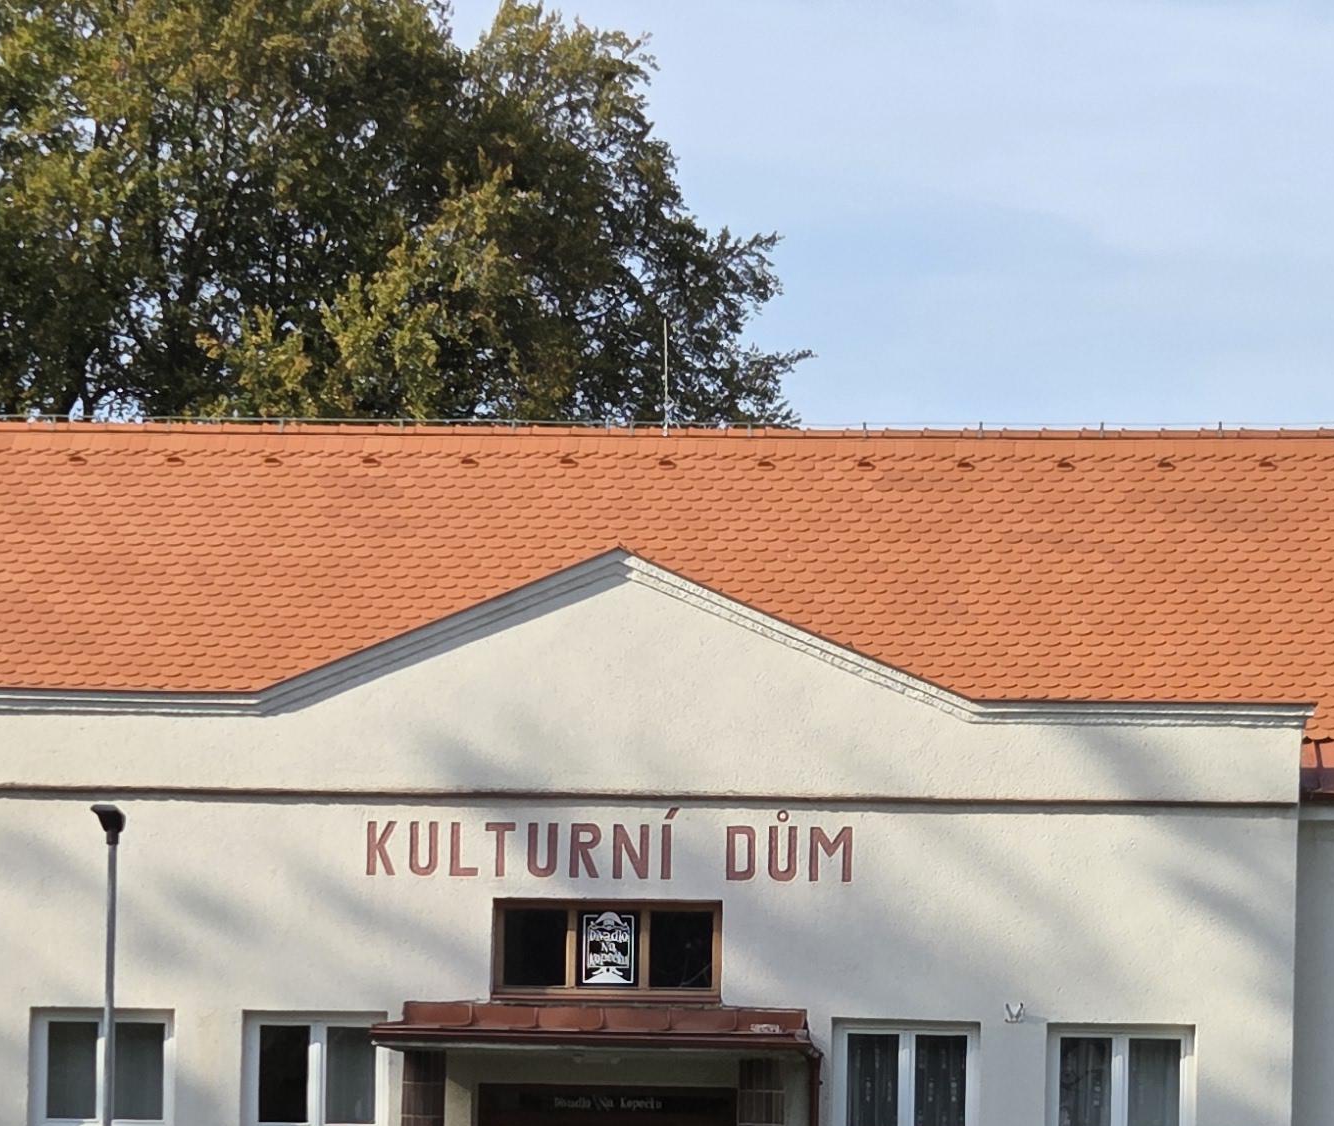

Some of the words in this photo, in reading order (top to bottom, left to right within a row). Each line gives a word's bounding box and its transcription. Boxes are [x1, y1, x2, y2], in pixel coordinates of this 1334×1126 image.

[365, 807, 679, 880] KULTURNÍ
[725, 809, 854, 882] DŮM
[589, 929, 629, 942] Divadlo
